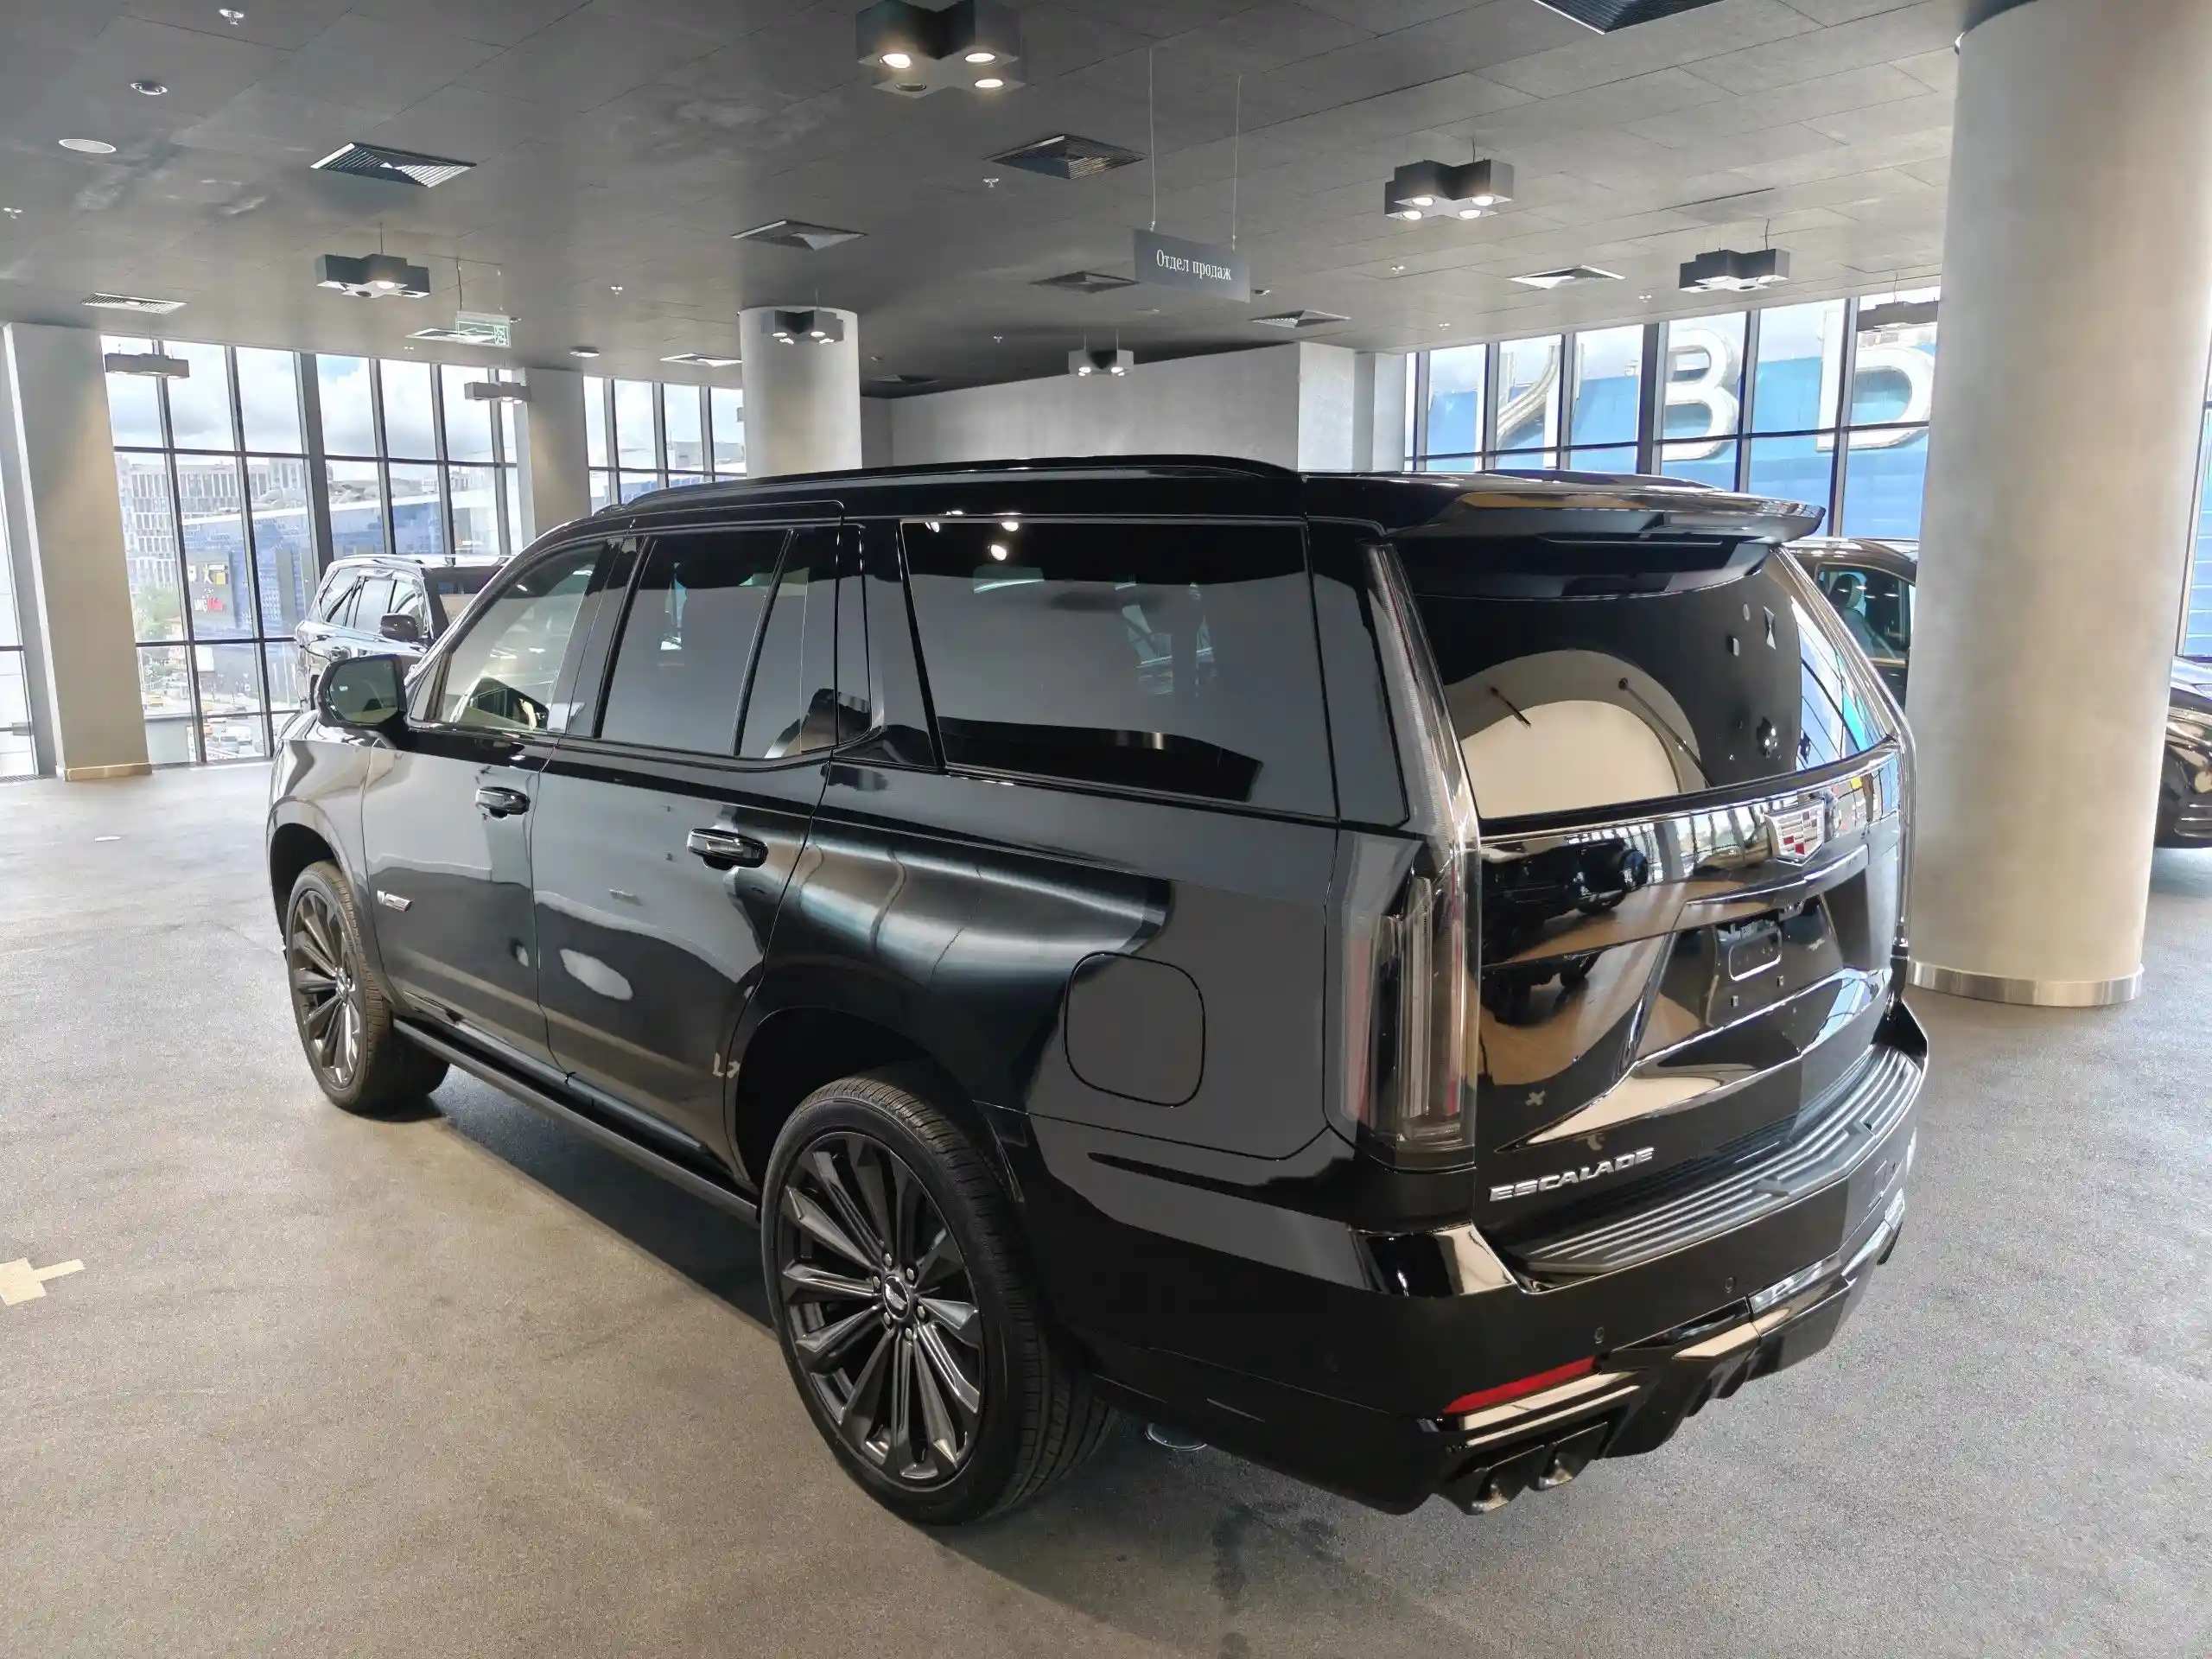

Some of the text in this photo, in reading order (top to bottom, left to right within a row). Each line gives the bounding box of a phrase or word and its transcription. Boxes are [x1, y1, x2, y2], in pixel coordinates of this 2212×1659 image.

[1156, 249, 1232, 281] Отдел продаж
[1489, 1147, 1655, 1201] ESCALADE
